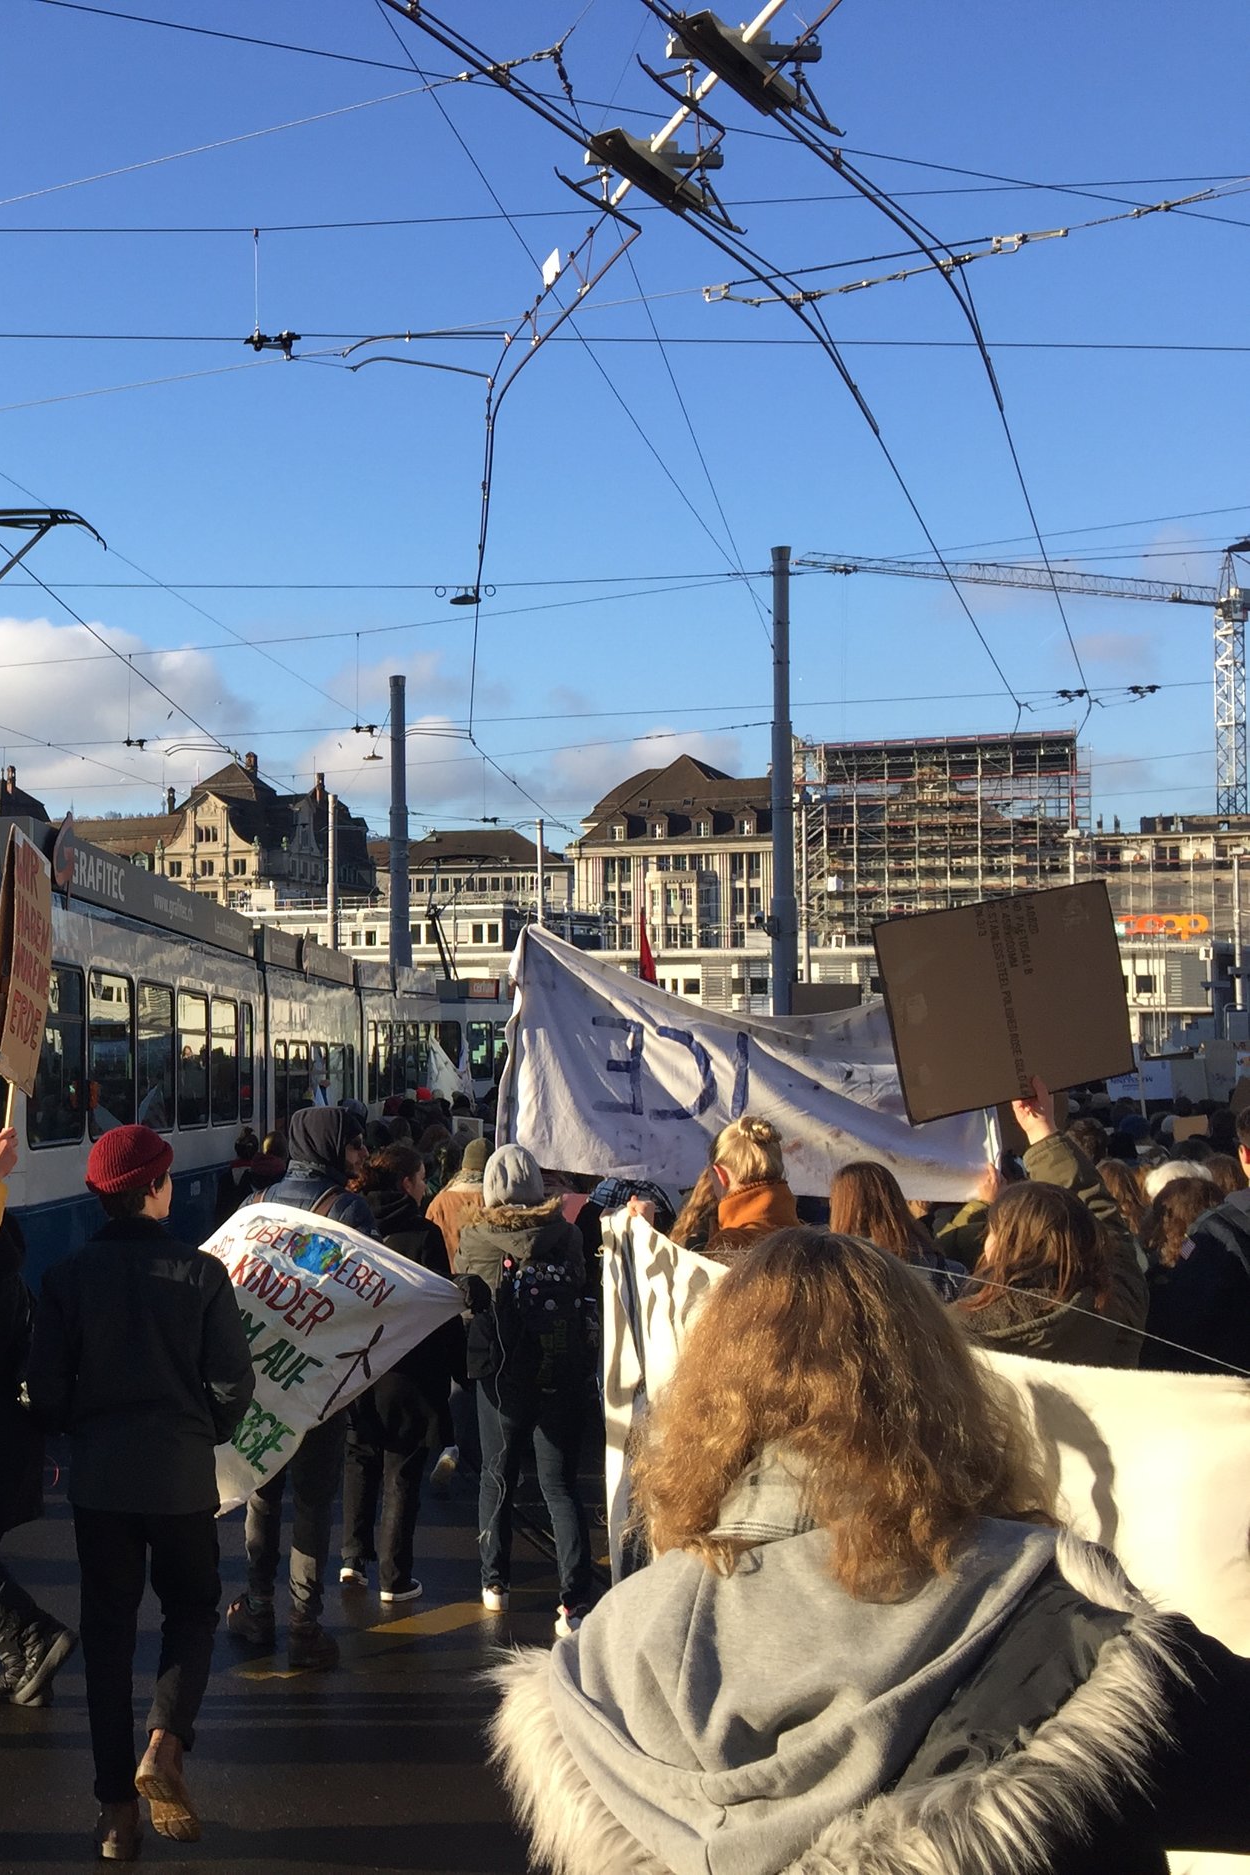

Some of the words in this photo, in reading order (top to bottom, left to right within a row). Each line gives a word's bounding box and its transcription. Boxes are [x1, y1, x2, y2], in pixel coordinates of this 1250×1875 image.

[1118, 914, 1210, 941] coop
[9, 989, 43, 1050] ERDE
[229, 1253, 335, 1337] KINDER
[321, 1255, 396, 1309] LEBEN
[252, 1338, 324, 1392] AUF
